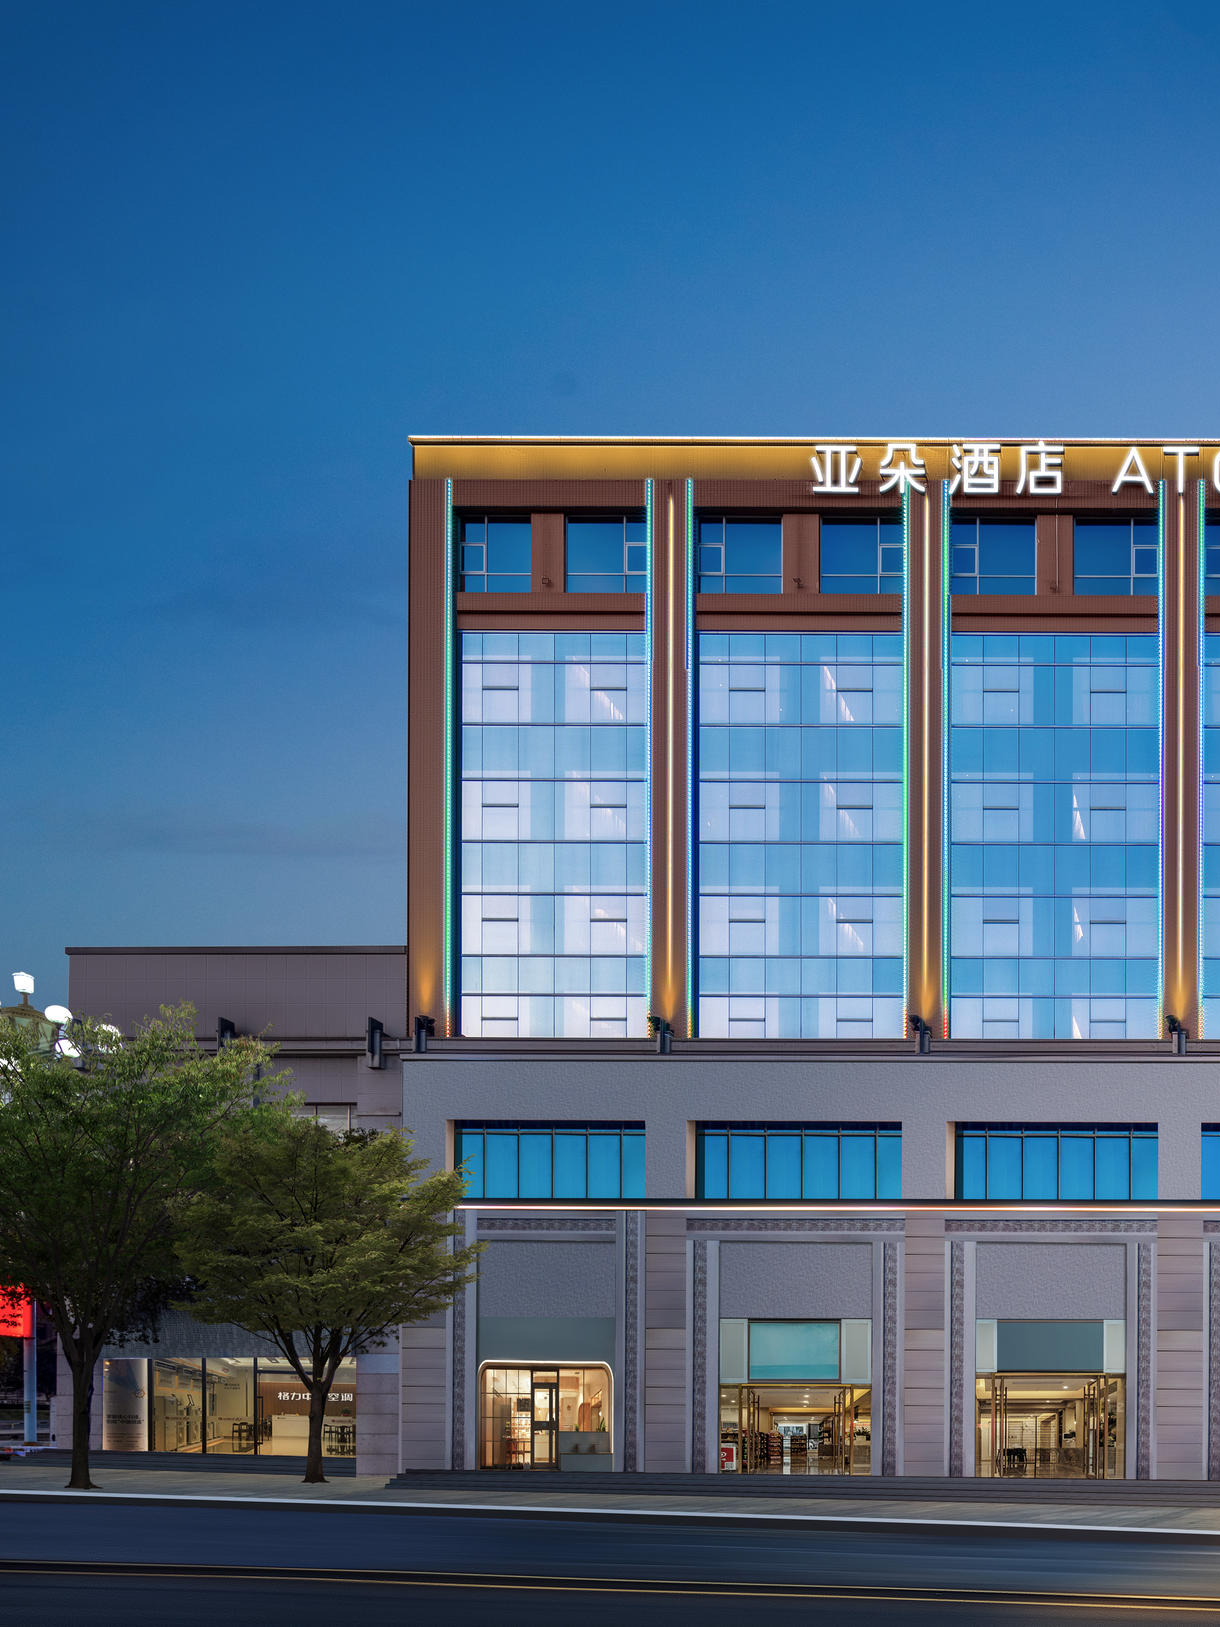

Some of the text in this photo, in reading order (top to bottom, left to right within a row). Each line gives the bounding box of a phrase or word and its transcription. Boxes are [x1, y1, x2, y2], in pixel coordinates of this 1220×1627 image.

[810, 441, 1065, 496] 亚朵酒店
[277, 1391, 353, 1402] 格力中空调
